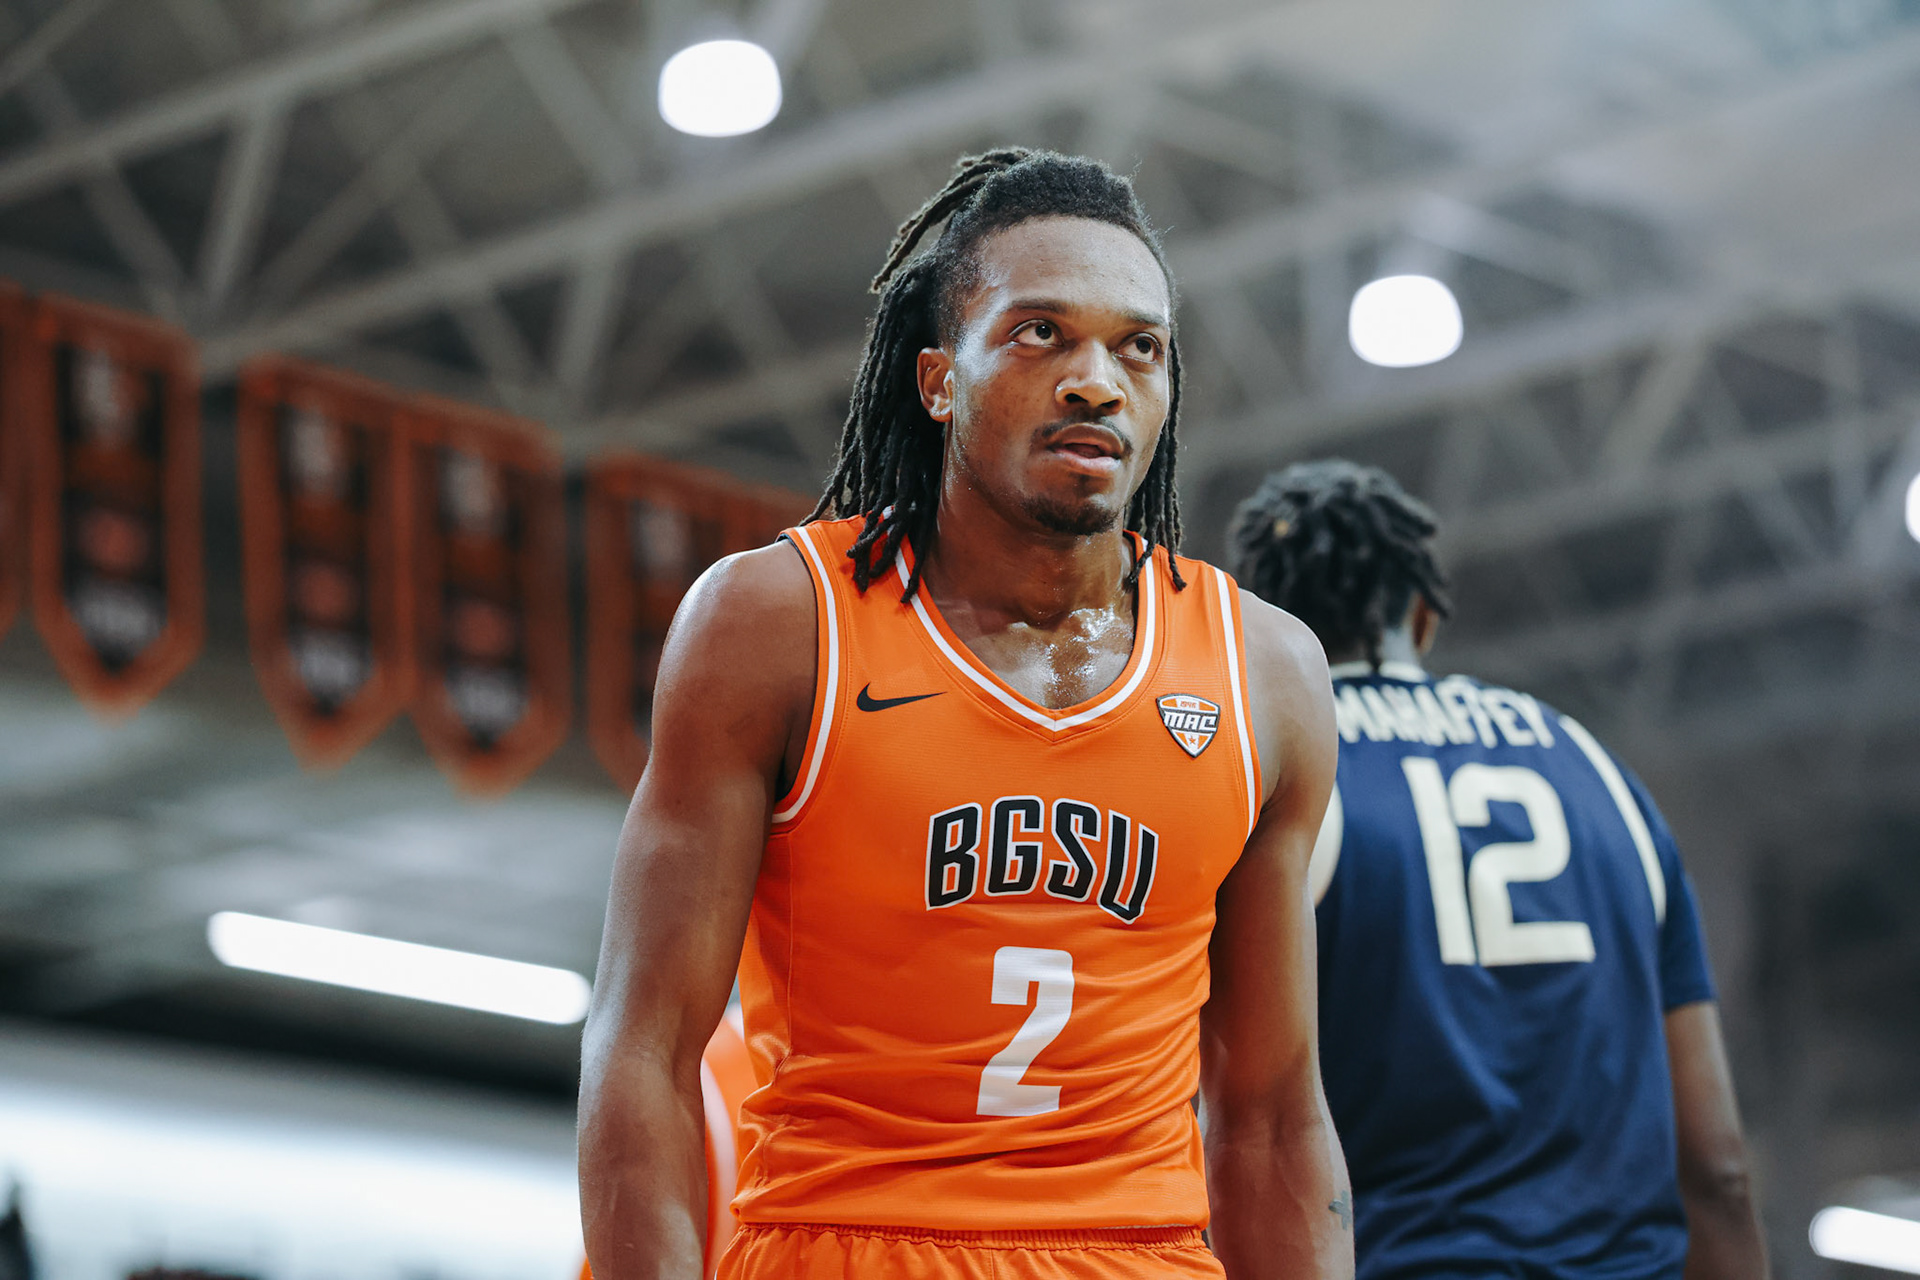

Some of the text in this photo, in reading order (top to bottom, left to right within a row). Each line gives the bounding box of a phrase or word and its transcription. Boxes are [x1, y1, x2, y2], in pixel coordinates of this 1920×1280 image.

[1163, 711, 1217, 732] MAC
[926, 795, 1159, 924] BGSU
[1401, 755, 1596, 967] 12
[976, 946, 1075, 1116] 2
